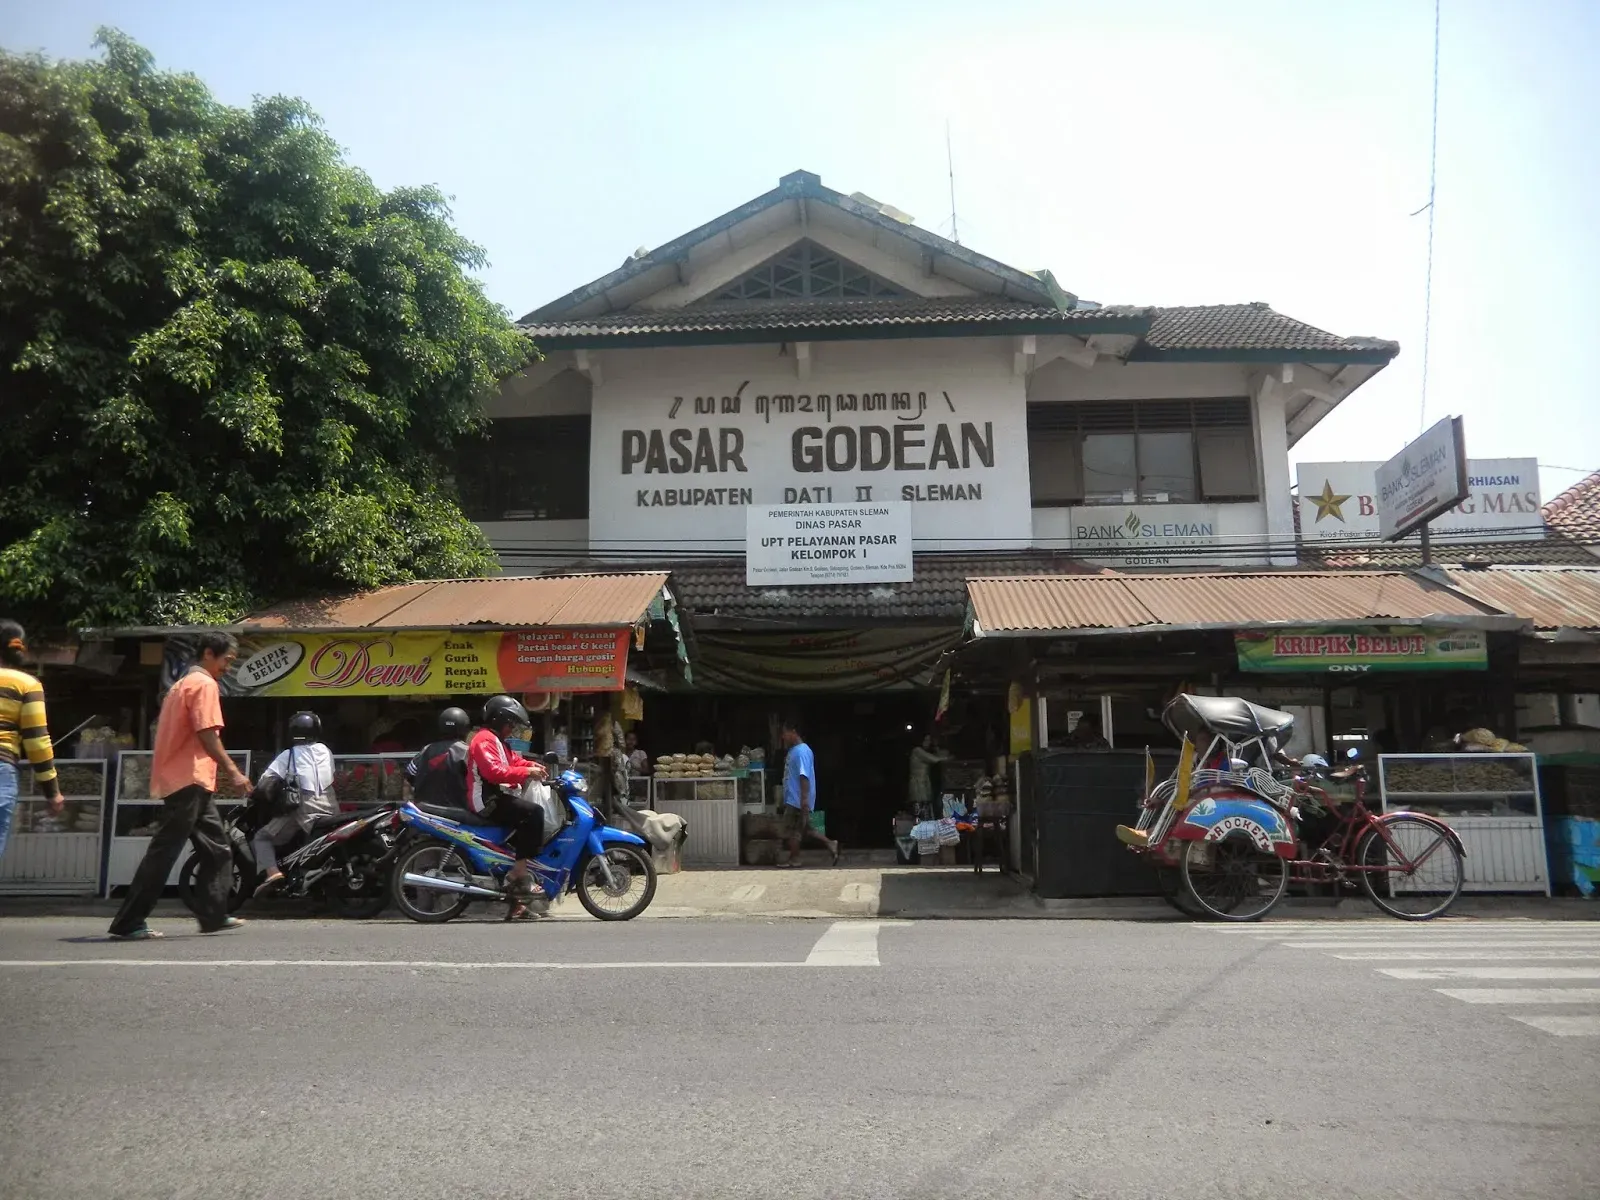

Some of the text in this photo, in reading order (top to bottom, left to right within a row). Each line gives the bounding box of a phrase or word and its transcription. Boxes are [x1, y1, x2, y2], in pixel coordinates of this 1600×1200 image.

[621, 421, 995, 475] PASAR GODEAN
[1380, 474, 1404, 502] BANK
[1410, 444, 1446, 481] SLEMAN
[1468, 475, 1520, 487] RHIASAN
[636, 483, 982, 507] KABUPATEN DATI II SLEMAN
[1482, 491, 1537, 514] MAS
[768, 508, 889, 518] PEMERINTAH KABUPATEN SLEMAN
[795, 519, 862, 530] DINAS PASAR
[1077, 523, 1213, 539] BANK SLEMAN
[761, 534, 897, 547] UPT PELAYANAN PASAR
[791, 548, 867, 560] KELOMPOK I
[1125, 557, 1170, 565] GODEAN
[517, 633, 565, 642] Melayani
[444, 641, 474, 650] Enak
[517, 643, 549, 652] Partai
[551, 643, 578, 651] besar
[591, 642, 616, 650] kecil
[1273, 634, 1351, 656] KRIPIK
[1355, 634, 1426, 655] BELUT
[246, 645, 288, 673] KRIPIK
[304, 638, 432, 689] Dewi
[444, 653, 479, 663] Gurih
[517, 653, 616, 664] dengan harga grosir
[253, 656, 290, 681] BELUT
[445, 667, 488, 677] Renyah
[567, 664, 615, 674] Hubungi:
[1328, 664, 1371, 672] ONY
[445, 679, 487, 690] Bergizi
[1213, 818, 1269, 842] ROCKET
